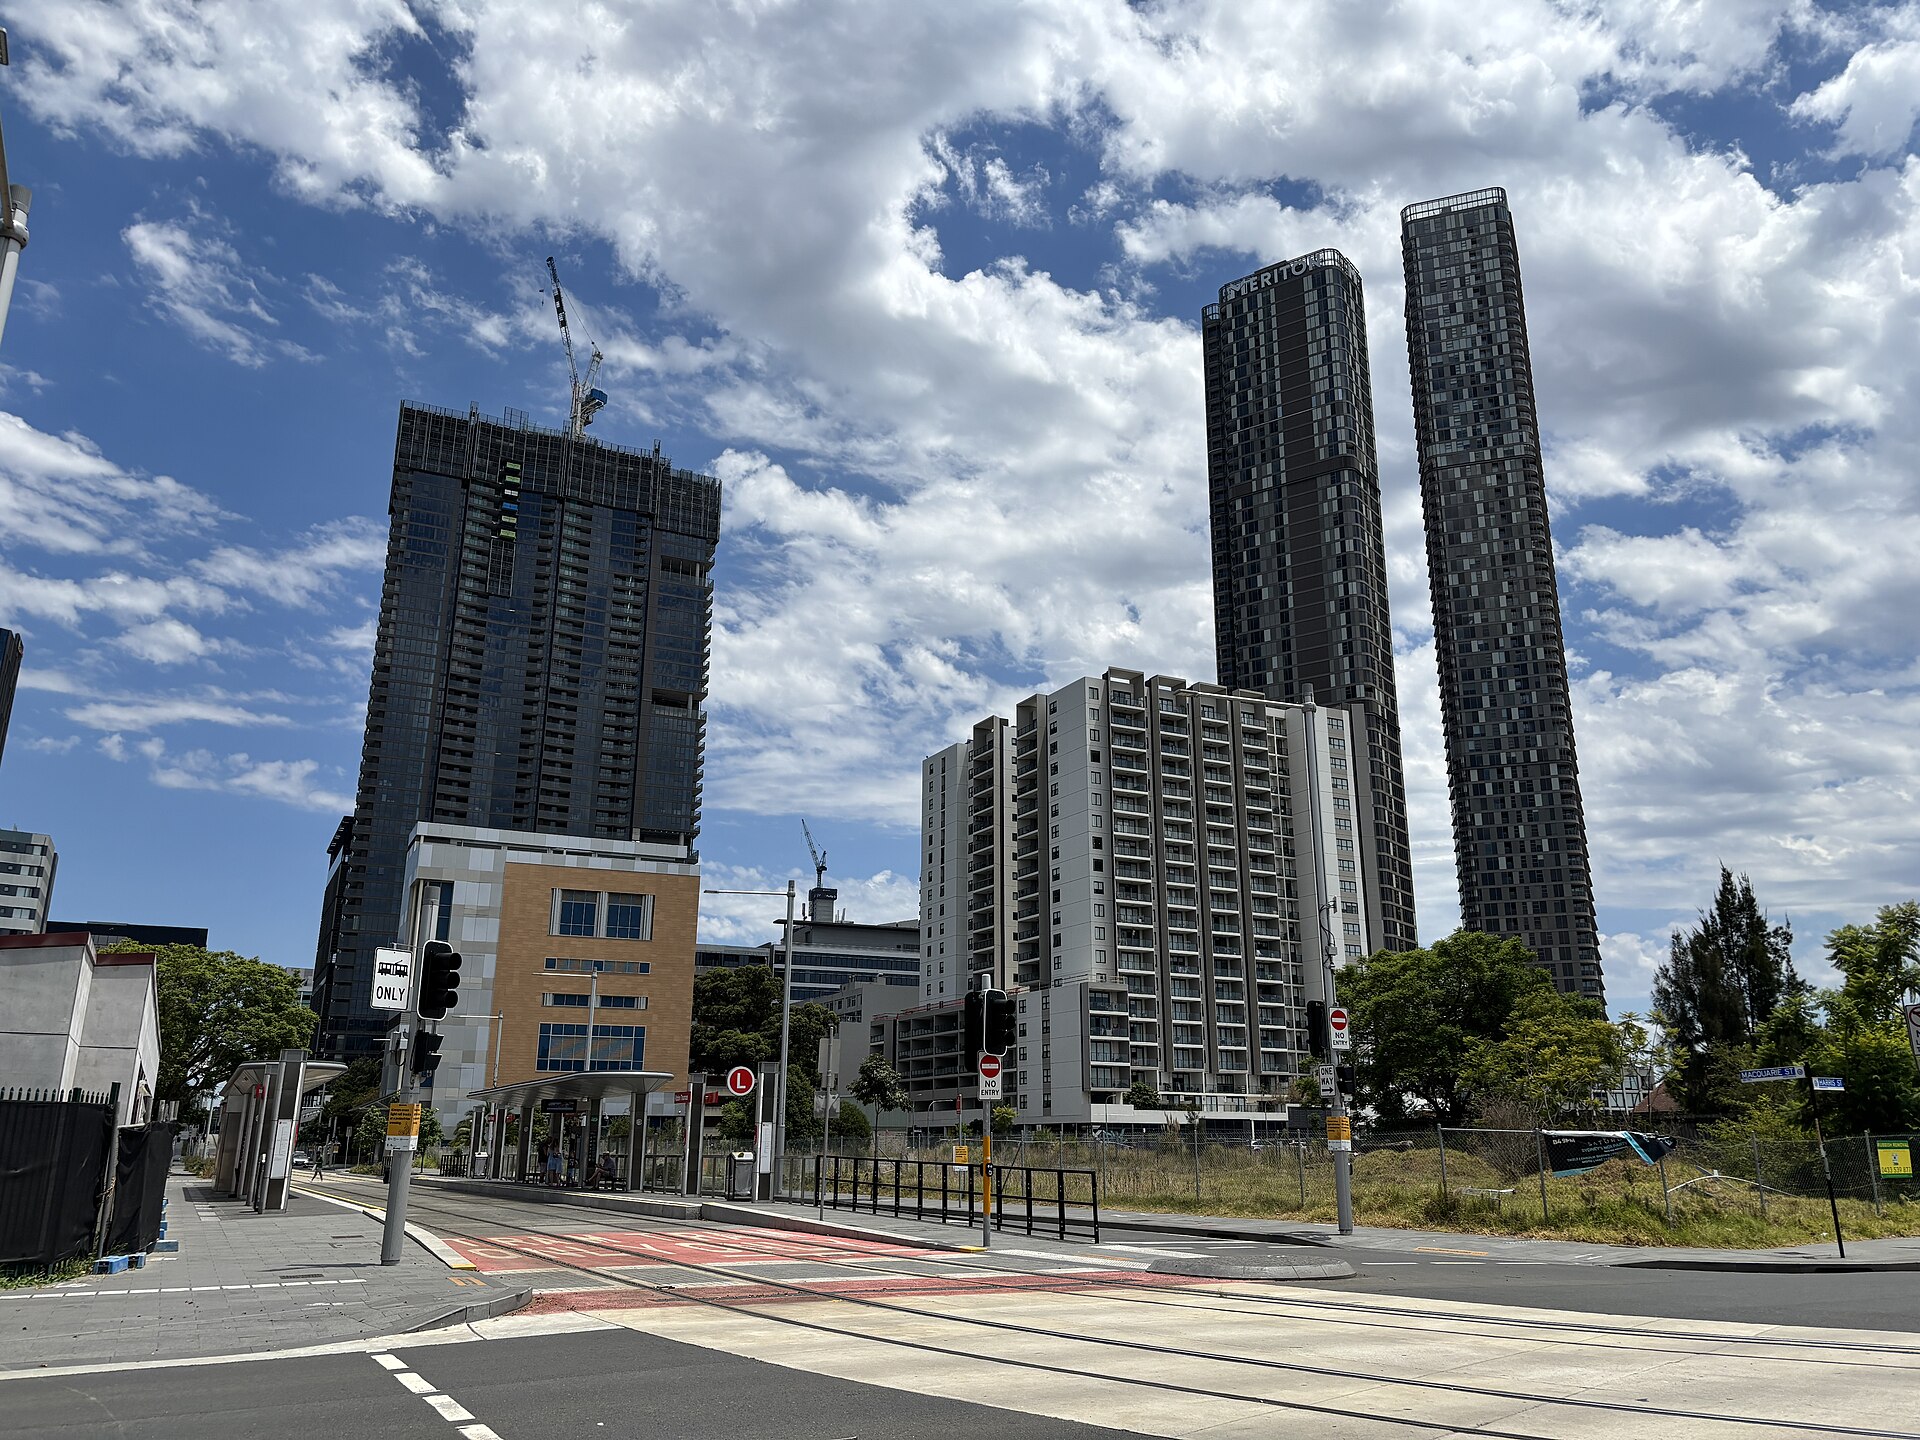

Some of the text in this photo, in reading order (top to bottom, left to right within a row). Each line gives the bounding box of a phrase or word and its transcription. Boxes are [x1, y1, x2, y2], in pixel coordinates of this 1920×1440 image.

[1226, 252, 1324, 301] MERITON
[376, 985, 405, 1001] ONLY
[1321, 1067, 1333, 1075] ONE
[1741, 1067, 1794, 1079] MACQUARIE ST
[736, 1072, 746, 1089] L
[984, 1080, 997, 1088] NO
[1321, 1077, 1334, 1086] WAY
[1819, 1079, 1836, 1087] HARRIS
